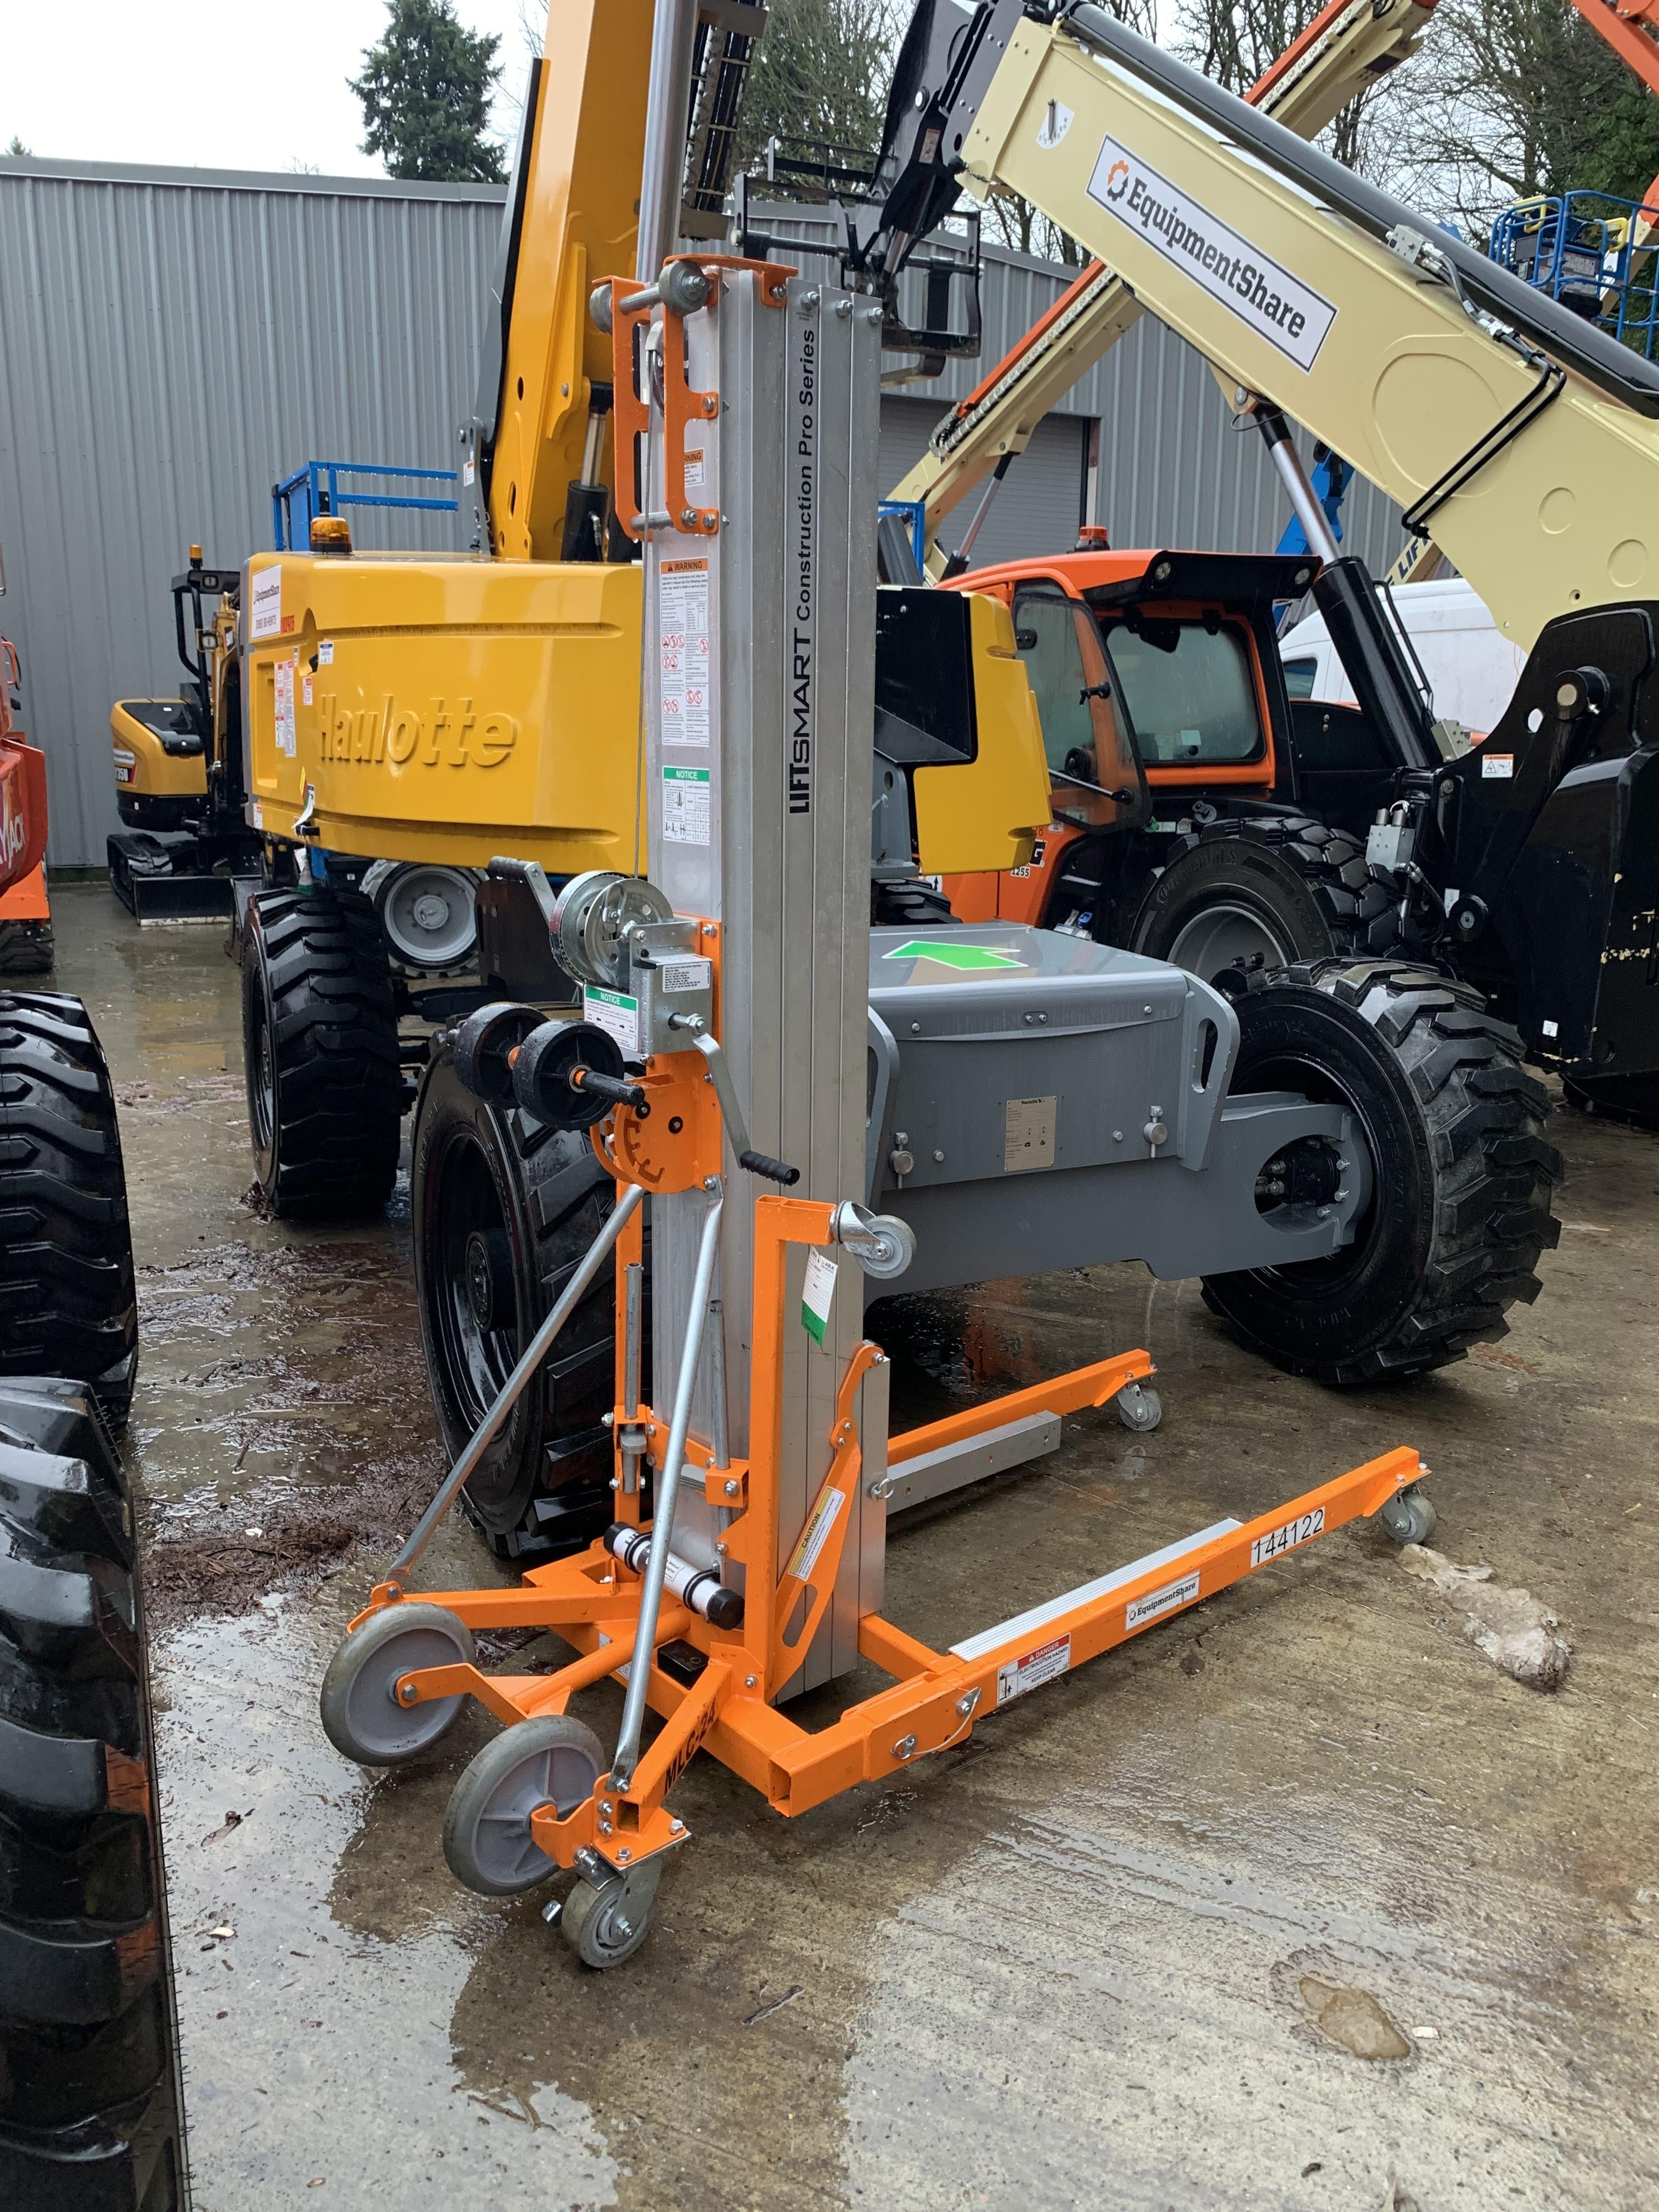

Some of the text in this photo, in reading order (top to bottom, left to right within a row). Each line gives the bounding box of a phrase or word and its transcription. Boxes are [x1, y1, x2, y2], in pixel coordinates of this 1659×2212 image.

[1126, 177, 1306, 338] EquipmentShare
[799, 330, 815, 405] Series
[798, 415, 812, 456] Pro
[797, 465, 812, 621] Construction
[674, 561, 703, 571] WARNING
[319, 693, 517, 767] Haulotte
[789, 628, 810, 813] LIFTSMART
[676, 770, 698, 780] NOTICE
[600, 992, 620, 1005] NOTICE
[802, 1513, 820, 1548] CAUTION
[1254, 1509, 1323, 1563] 144122
[1137, 1583, 1195, 1616] EquipmentShare
[1019, 1654, 1052, 1675] ELECTROCUTION
[1052, 1646, 1068, 1657] HAZARD
[1035, 1641, 1059, 1658] DANGER
[1031, 1667, 1056, 1683] KEEP CLEAR
